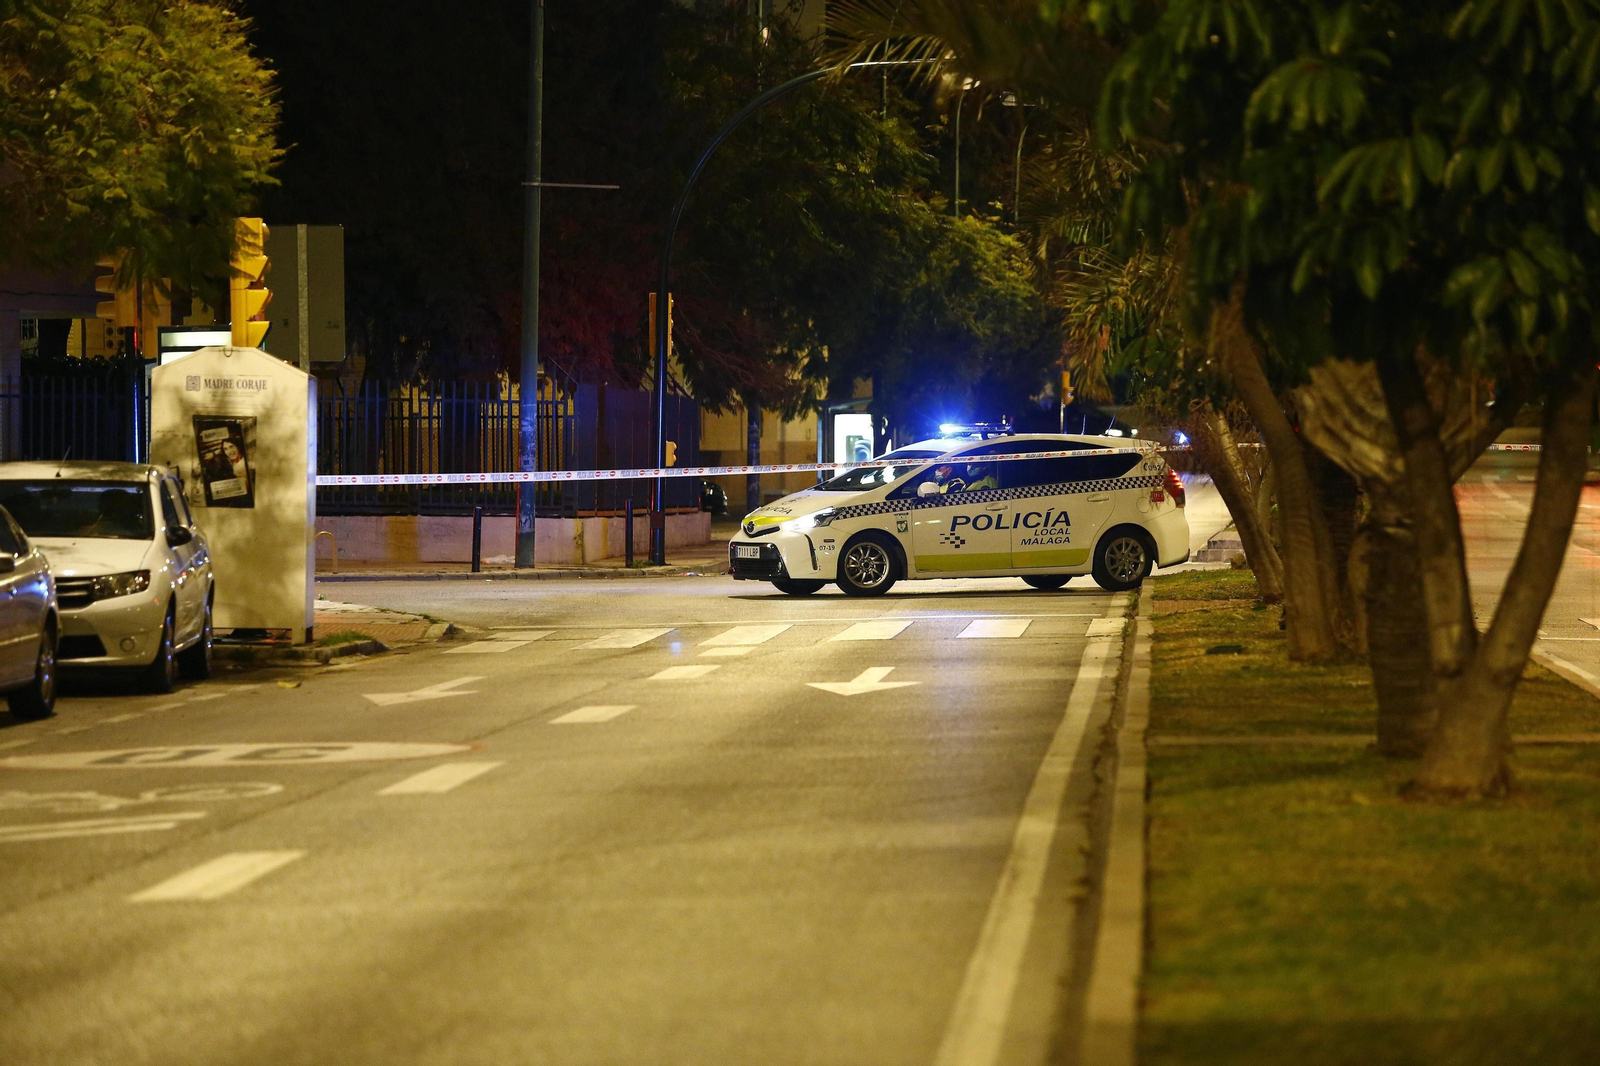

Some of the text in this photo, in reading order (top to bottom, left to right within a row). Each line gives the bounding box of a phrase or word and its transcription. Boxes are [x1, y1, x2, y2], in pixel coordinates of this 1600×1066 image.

[204, 378, 267, 392] MADRE CORAJE
[950, 507, 1071, 532] POLICÍA
[1034, 528, 1071, 536] LOCAL
[1020, 536, 1070, 546] MALAGA
